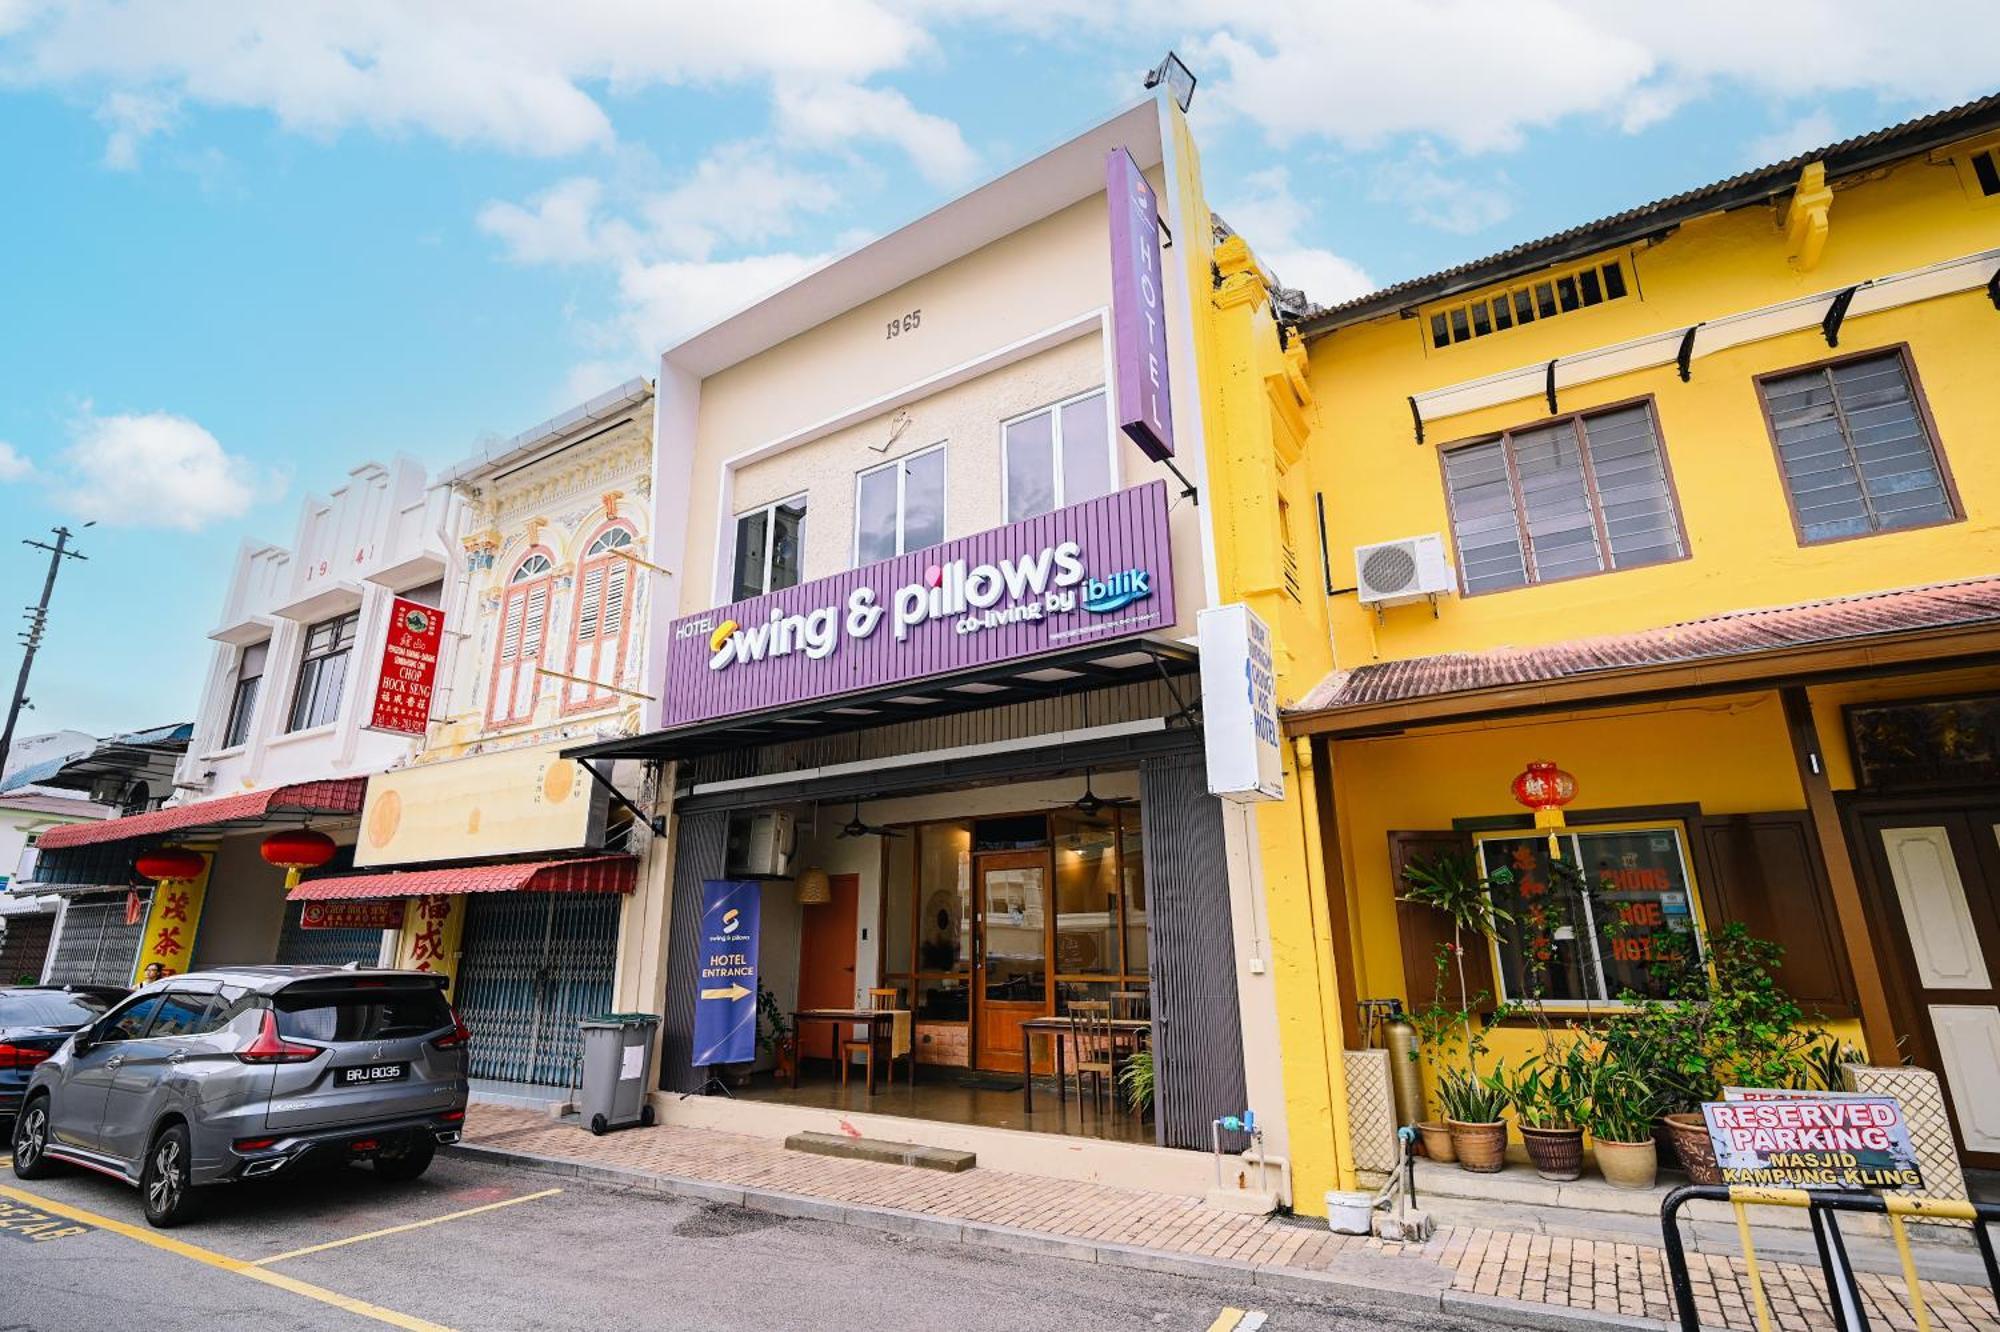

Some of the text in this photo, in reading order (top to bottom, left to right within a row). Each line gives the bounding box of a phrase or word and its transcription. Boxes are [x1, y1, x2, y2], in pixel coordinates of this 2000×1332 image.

[886, 309, 921, 340] 1965
[1139, 236, 1163, 430] HOTEL
[676, 618, 715, 641] HOTEL
[847, 586, 884, 639] &
[955, 601, 1044, 635] co-living
[1045, 589, 1076, 613] by
[1081, 568, 1151, 603] ibilik
[400, 666, 422, 681] CHOP
[382, 676, 432, 698] HOCK SENG
[1254, 709, 1278, 748] HOTEL
[415, 893, 451, 971] 福成
[702, 967, 754, 977] ENTRANCE
[710, 954, 746, 966] HOTEL
[346, 1069, 370, 1082] BRJ
[371, 1066, 400, 1080] 8035
[1712, 1104, 1896, 1128] RESERVED
[1730, 1126, 1890, 1151] PARKING
[1767, 1152, 1858, 1168] MASJID
[1721, 1167, 1921, 1185] KAMPUNG KLING
